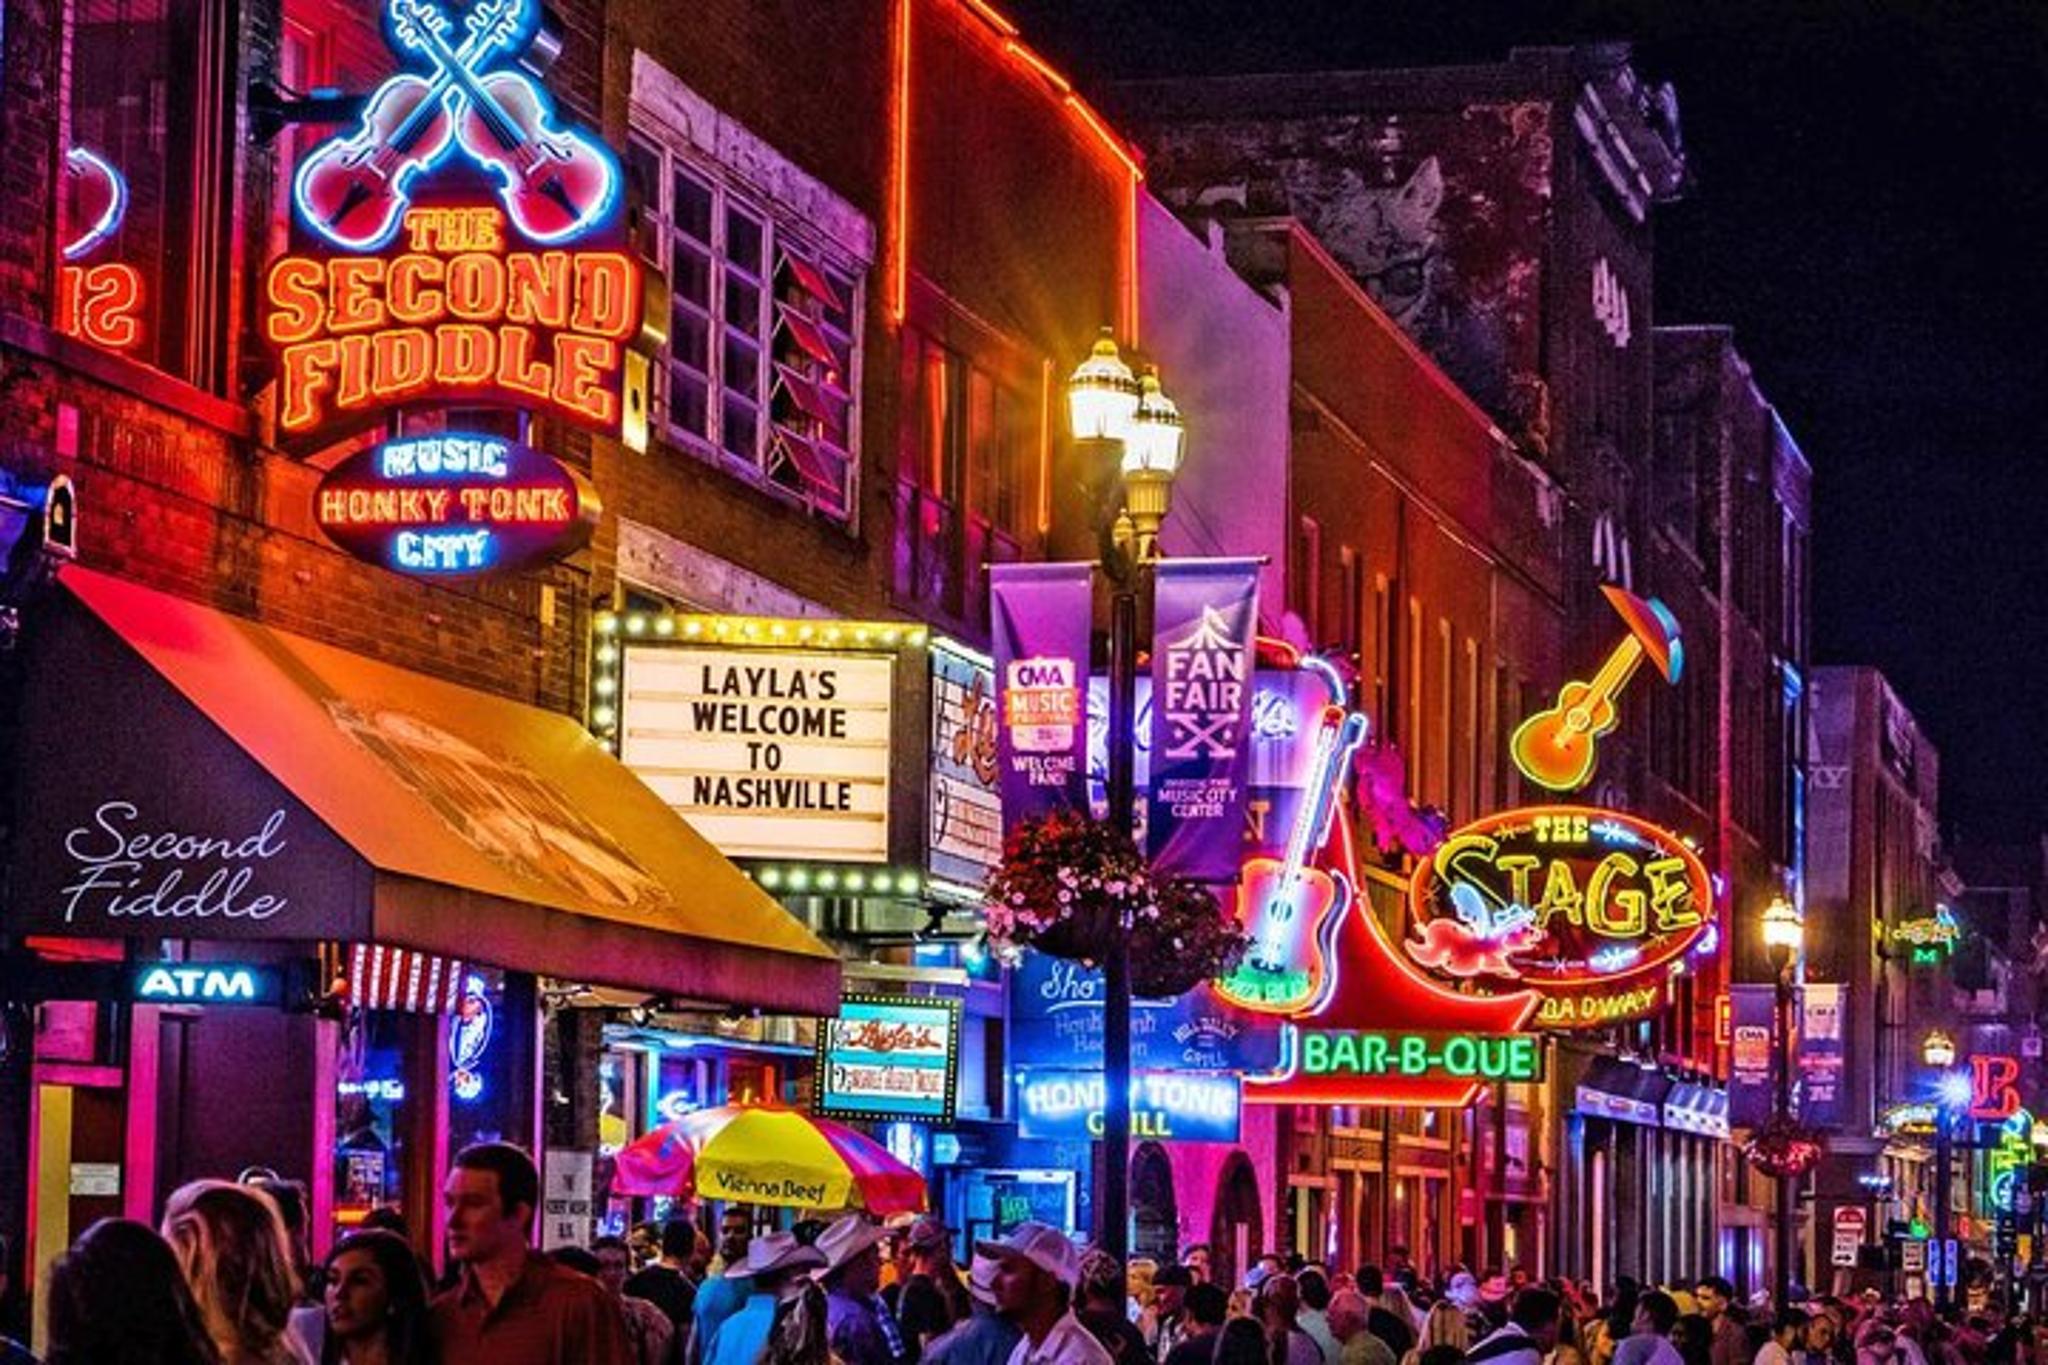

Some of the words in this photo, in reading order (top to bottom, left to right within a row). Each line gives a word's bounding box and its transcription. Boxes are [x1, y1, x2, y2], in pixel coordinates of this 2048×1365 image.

[404, 208, 500, 251] THE
[268, 252, 634, 342] SECOND
[282, 325, 617, 428] FIDDLE
[382, 439, 508, 478] MUSIC
[320, 488, 448, 523] HONKY
[460, 488, 570, 522] TONK
[397, 530, 490, 568] CITY
[701, 664, 837, 700] LAYLA'S
[1018, 666, 1065, 687] CMA
[1166, 650, 1245, 681] FAN
[1011, 691, 1074, 713] MUSIC
[1165, 681, 1242, 711] FAIR
[691, 701, 847, 738] WELCOME
[747, 742, 782, 772] TO
[1012, 756, 1076, 772] WELCOME
[692, 776, 852, 811] NASHVILLE
[1157, 789, 1204, 803] MUSIC
[1171, 803, 1225, 818] CENTER
[65, 802, 287, 864] Second
[1533, 815, 1590, 843] THE
[61, 861, 288, 923] Fiddle
[1434, 834, 1702, 938] STAGE
[139, 969, 255, 997] ATM
[1041, 959, 1105, 998] Sho
[1304, 1034, 1533, 1077] BAR-B-QUE
[1026, 1078, 1140, 1115] HON
[1146, 1074, 1237, 1117] TONK
[1086, 1111, 1172, 1135] GILL
[716, 1171, 780, 1198] Vienna
[784, 1180, 826, 1204] Beef
